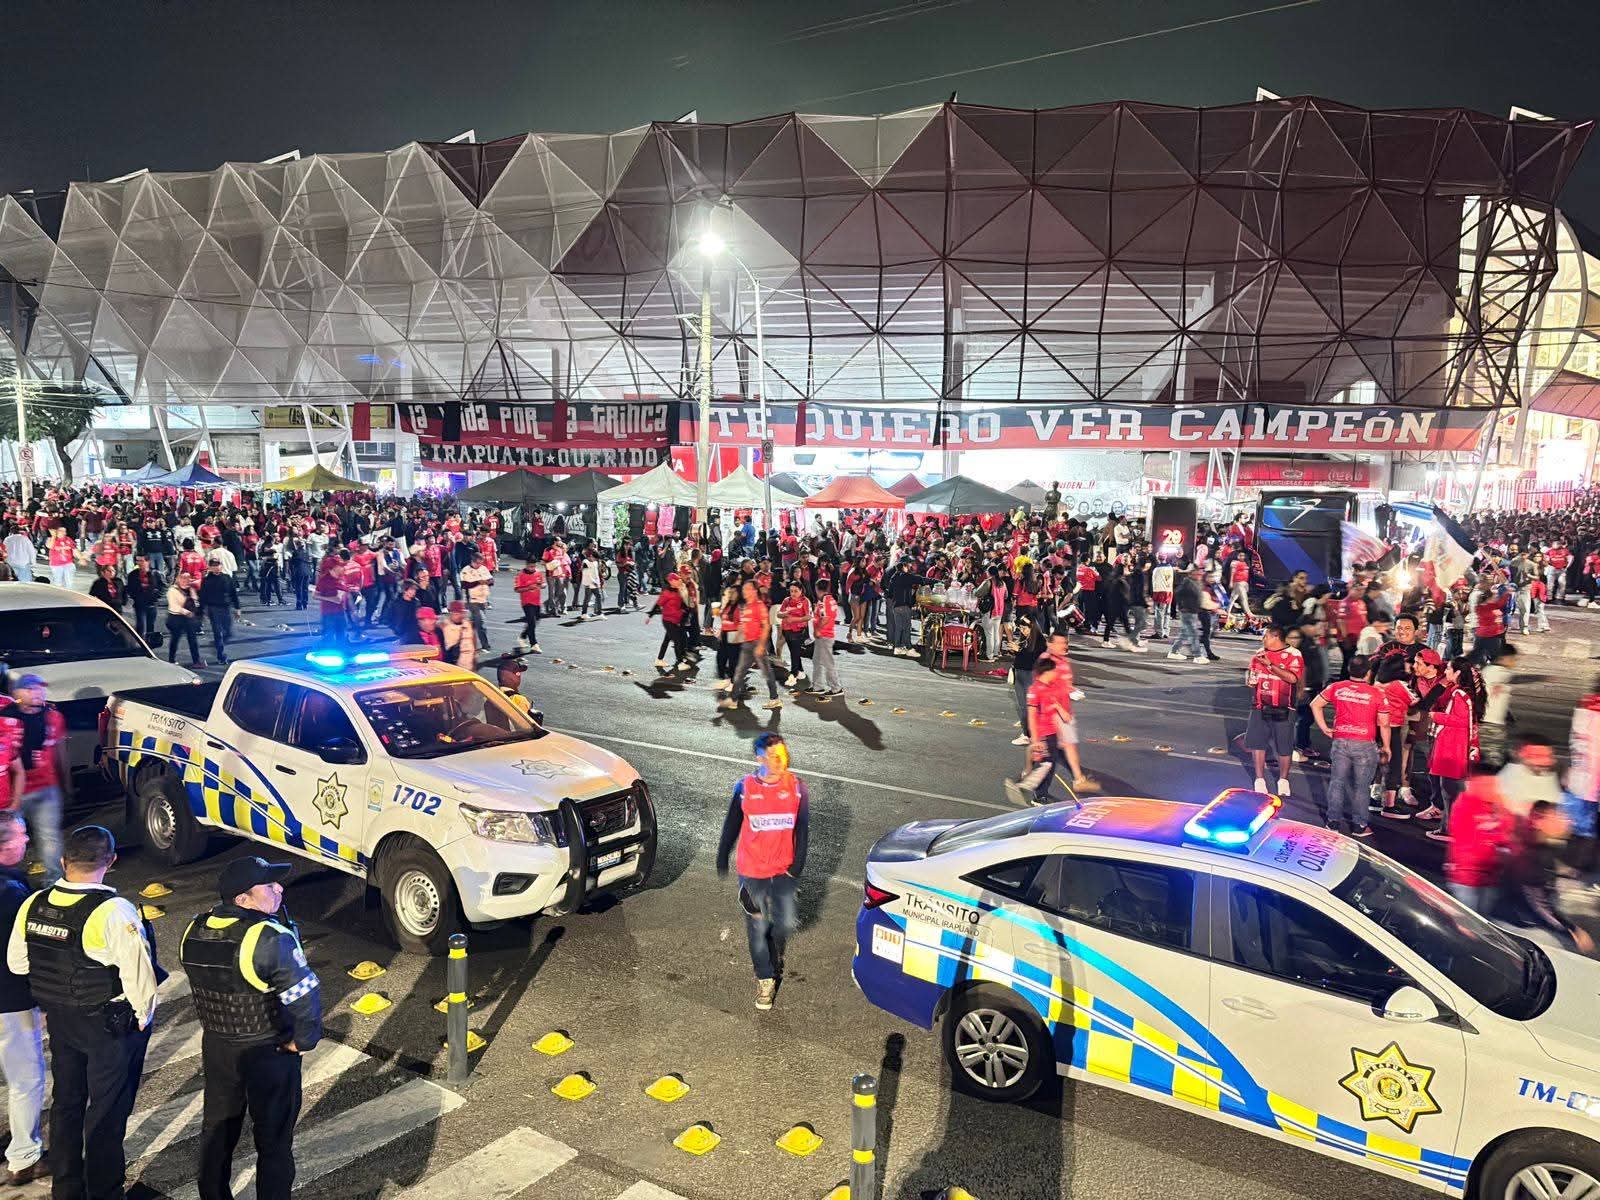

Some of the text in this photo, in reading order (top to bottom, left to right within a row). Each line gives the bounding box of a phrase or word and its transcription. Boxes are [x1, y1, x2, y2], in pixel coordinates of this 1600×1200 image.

[709, 406, 1437, 445] TE QUIERO VER CAMPEÓN
[430, 443, 658, 468] IRAPUATO QUERIDO
[393, 784, 442, 816] 1702
[903, 908, 980, 937] MUNICIPAL IRAPUATO
